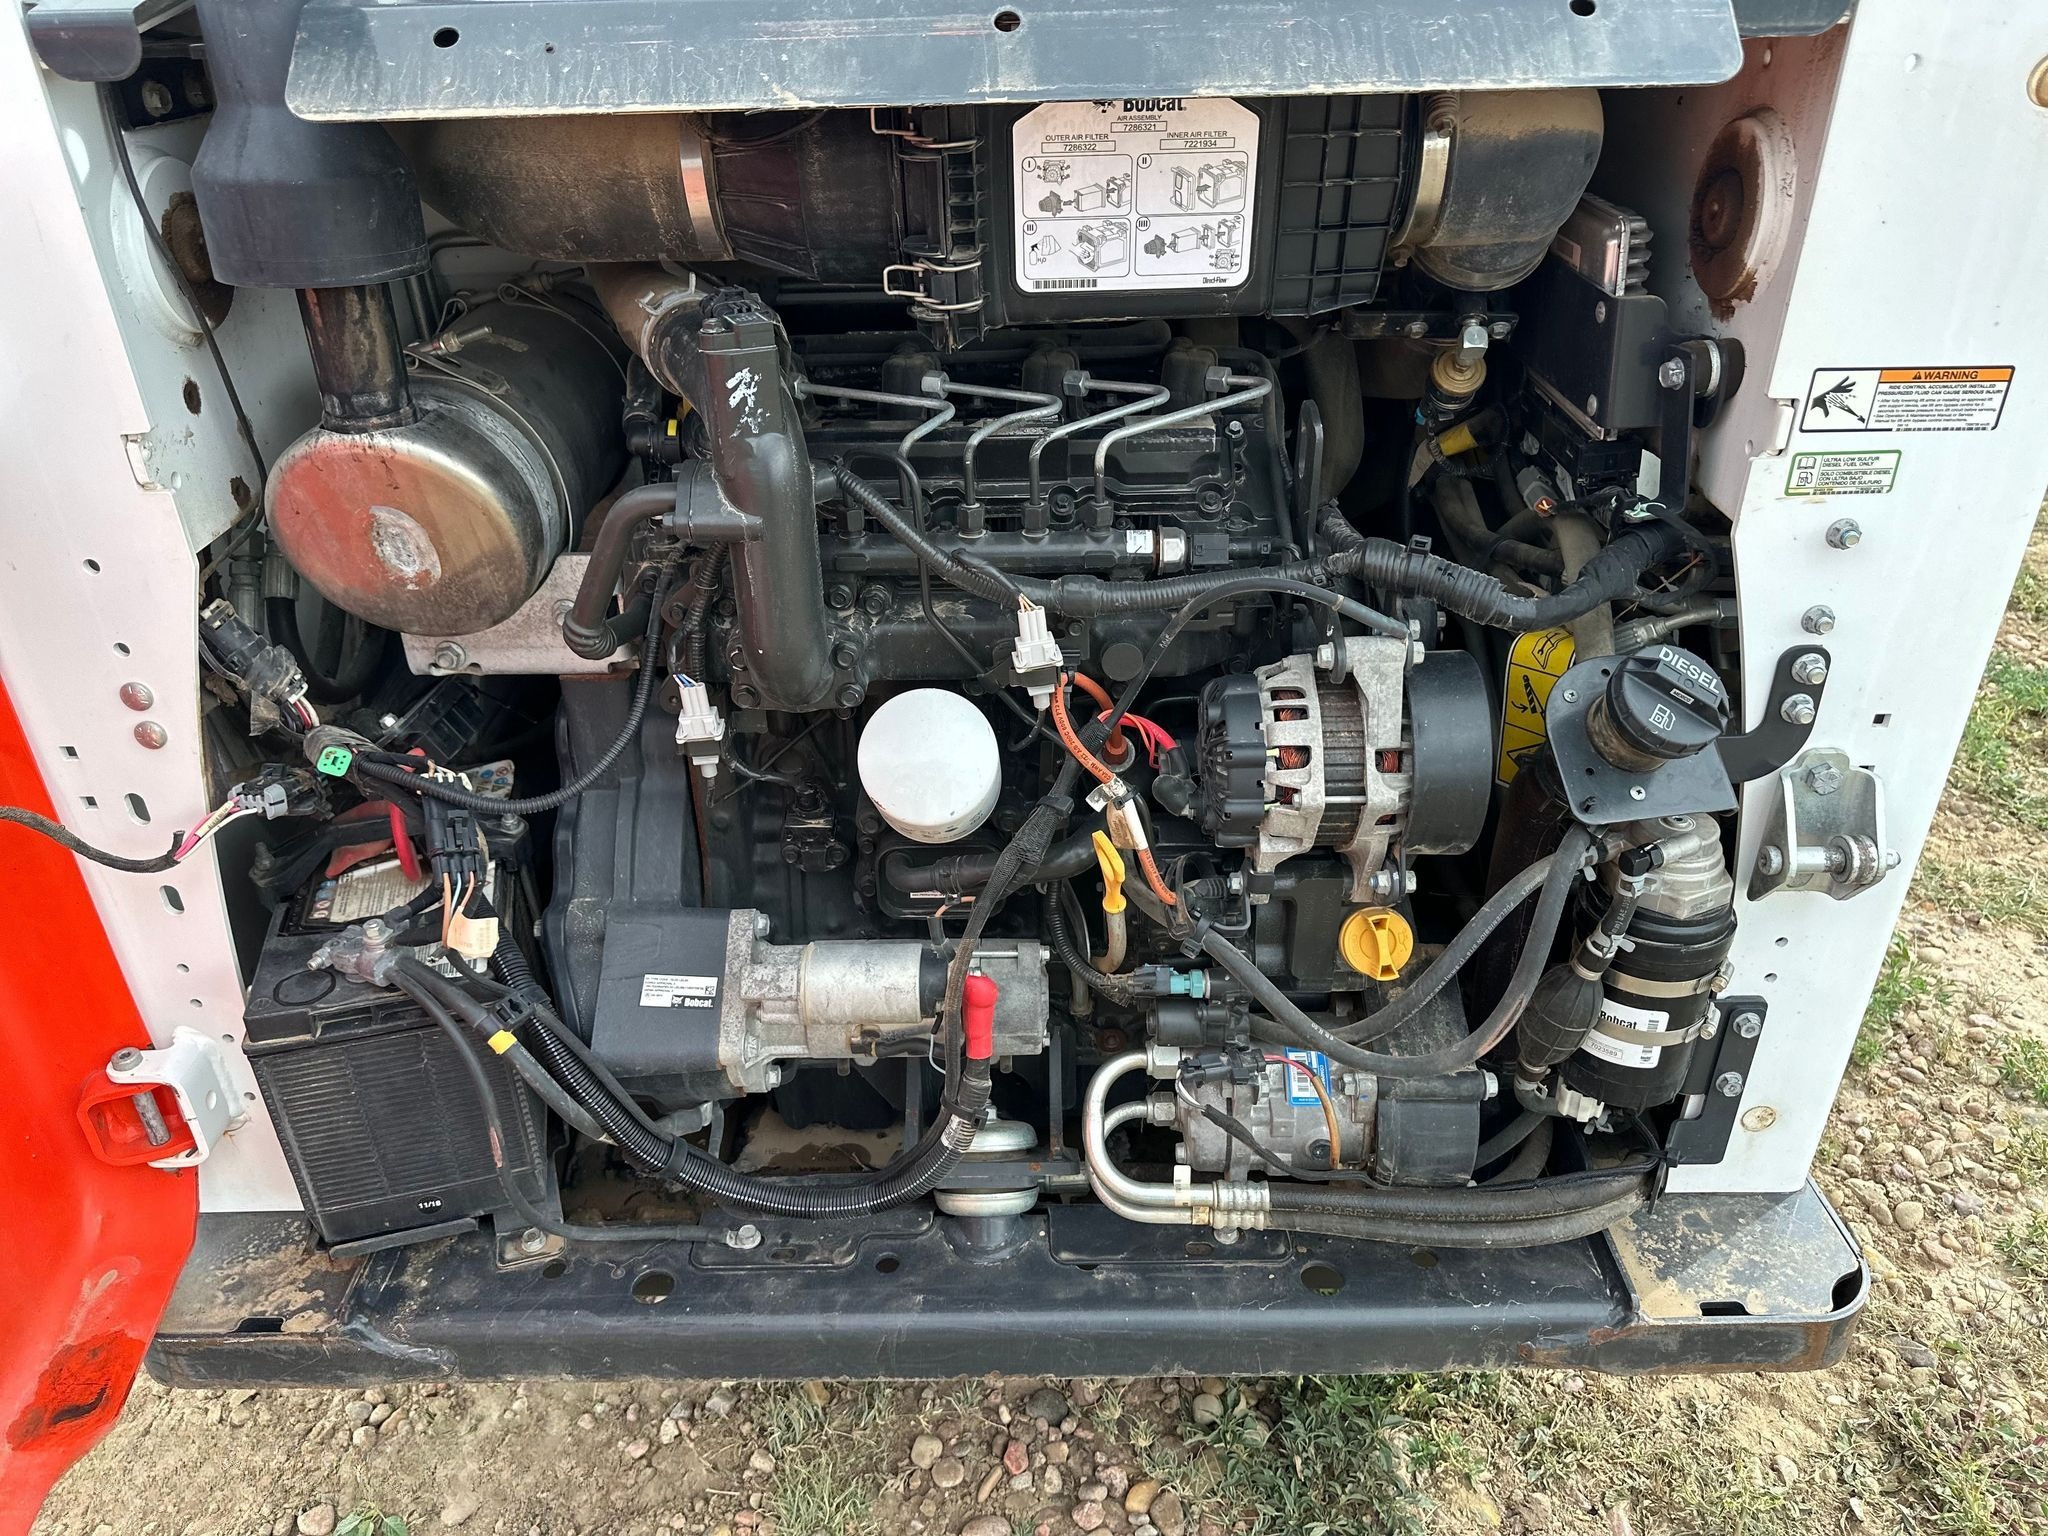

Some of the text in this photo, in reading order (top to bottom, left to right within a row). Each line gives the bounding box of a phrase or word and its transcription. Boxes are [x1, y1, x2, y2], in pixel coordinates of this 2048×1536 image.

[1123, 98, 1183, 113] Bobcat
[1123, 123, 1157, 131] 7286321
[1063, 143, 1097, 151] 7286322
[1184, 140, 1217, 148] 7221934
[1924, 371, 1979, 380] WARNING
[1659, 646, 1720, 694] DIESEL
[1673, 690, 1691, 702] MEXICO
[684, 998, 712, 1008] Bobcat
[1600, 1010, 1638, 1030] Bobcat
[1590, 1041, 1618, 1057] 7023589
